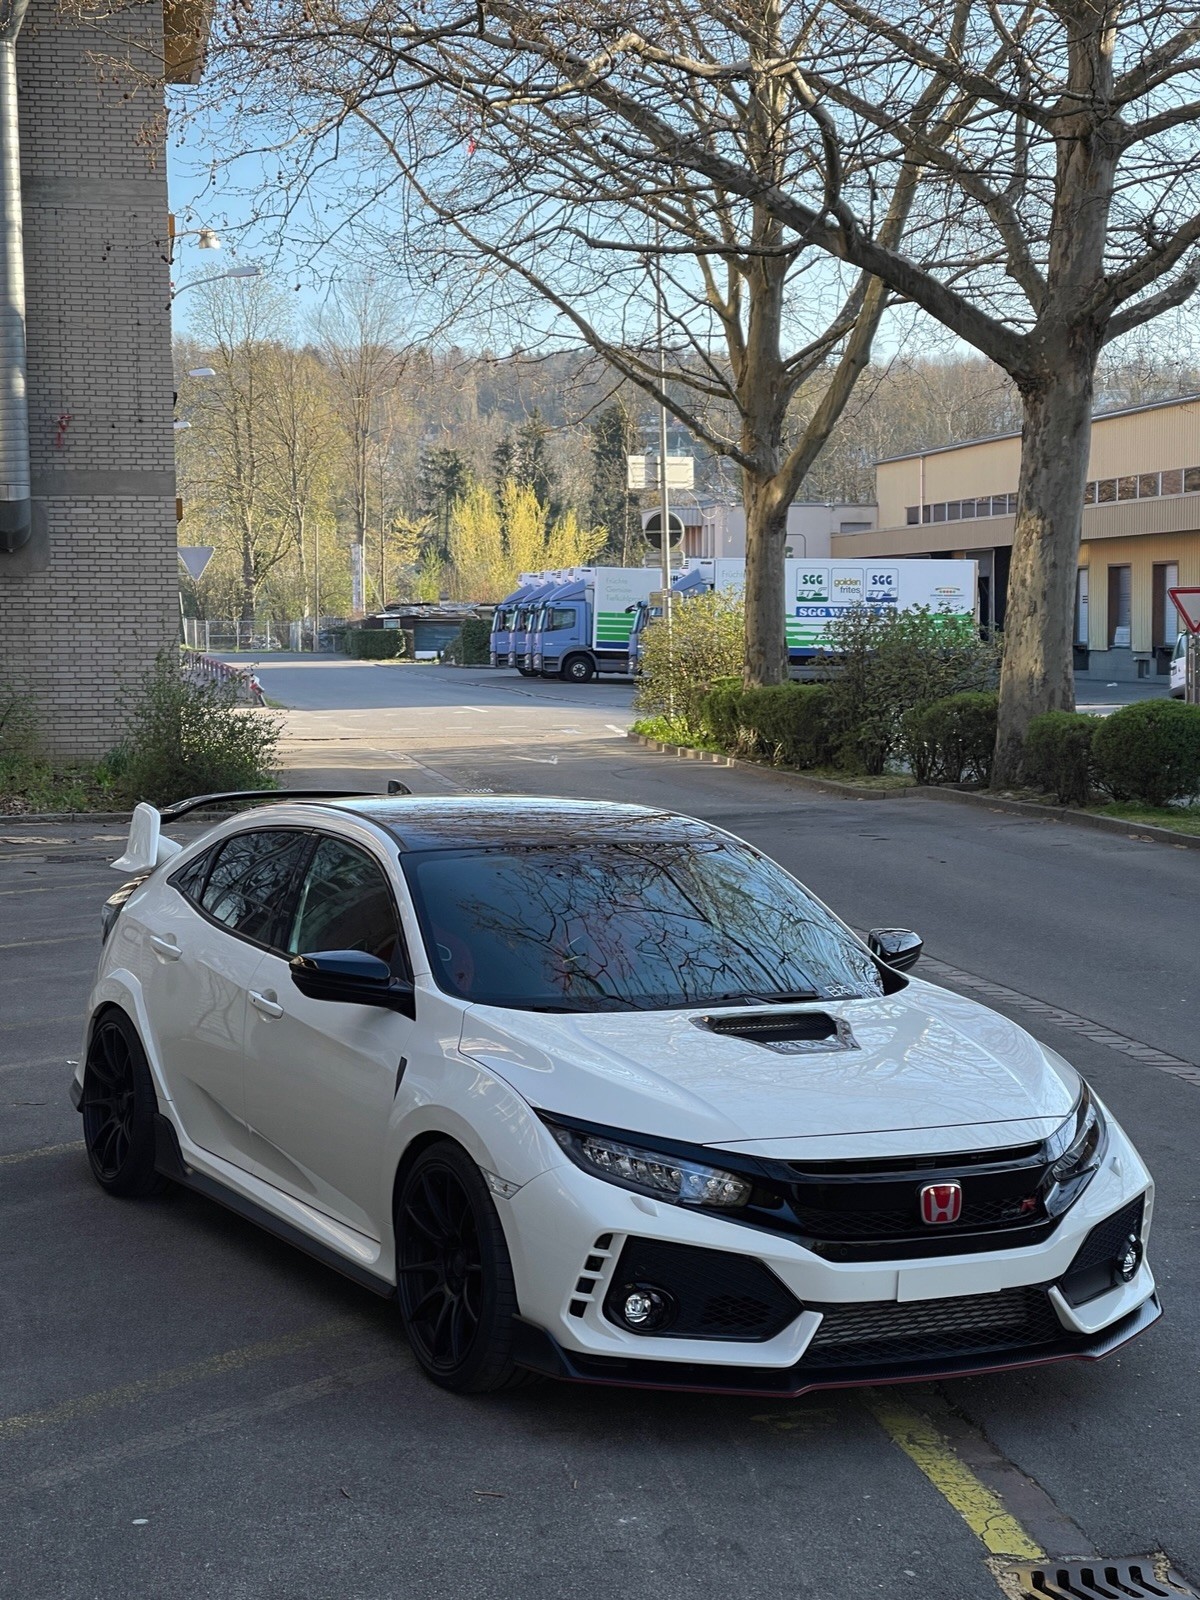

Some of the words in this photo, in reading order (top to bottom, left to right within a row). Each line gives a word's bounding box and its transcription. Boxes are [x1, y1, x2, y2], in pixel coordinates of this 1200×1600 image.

[802, 574, 823, 585] SGG
[833, 577, 862, 588] golden
[871, 574, 893, 586] SGG
[840, 586, 861, 594] frites
[799, 608, 826, 617] SGG
